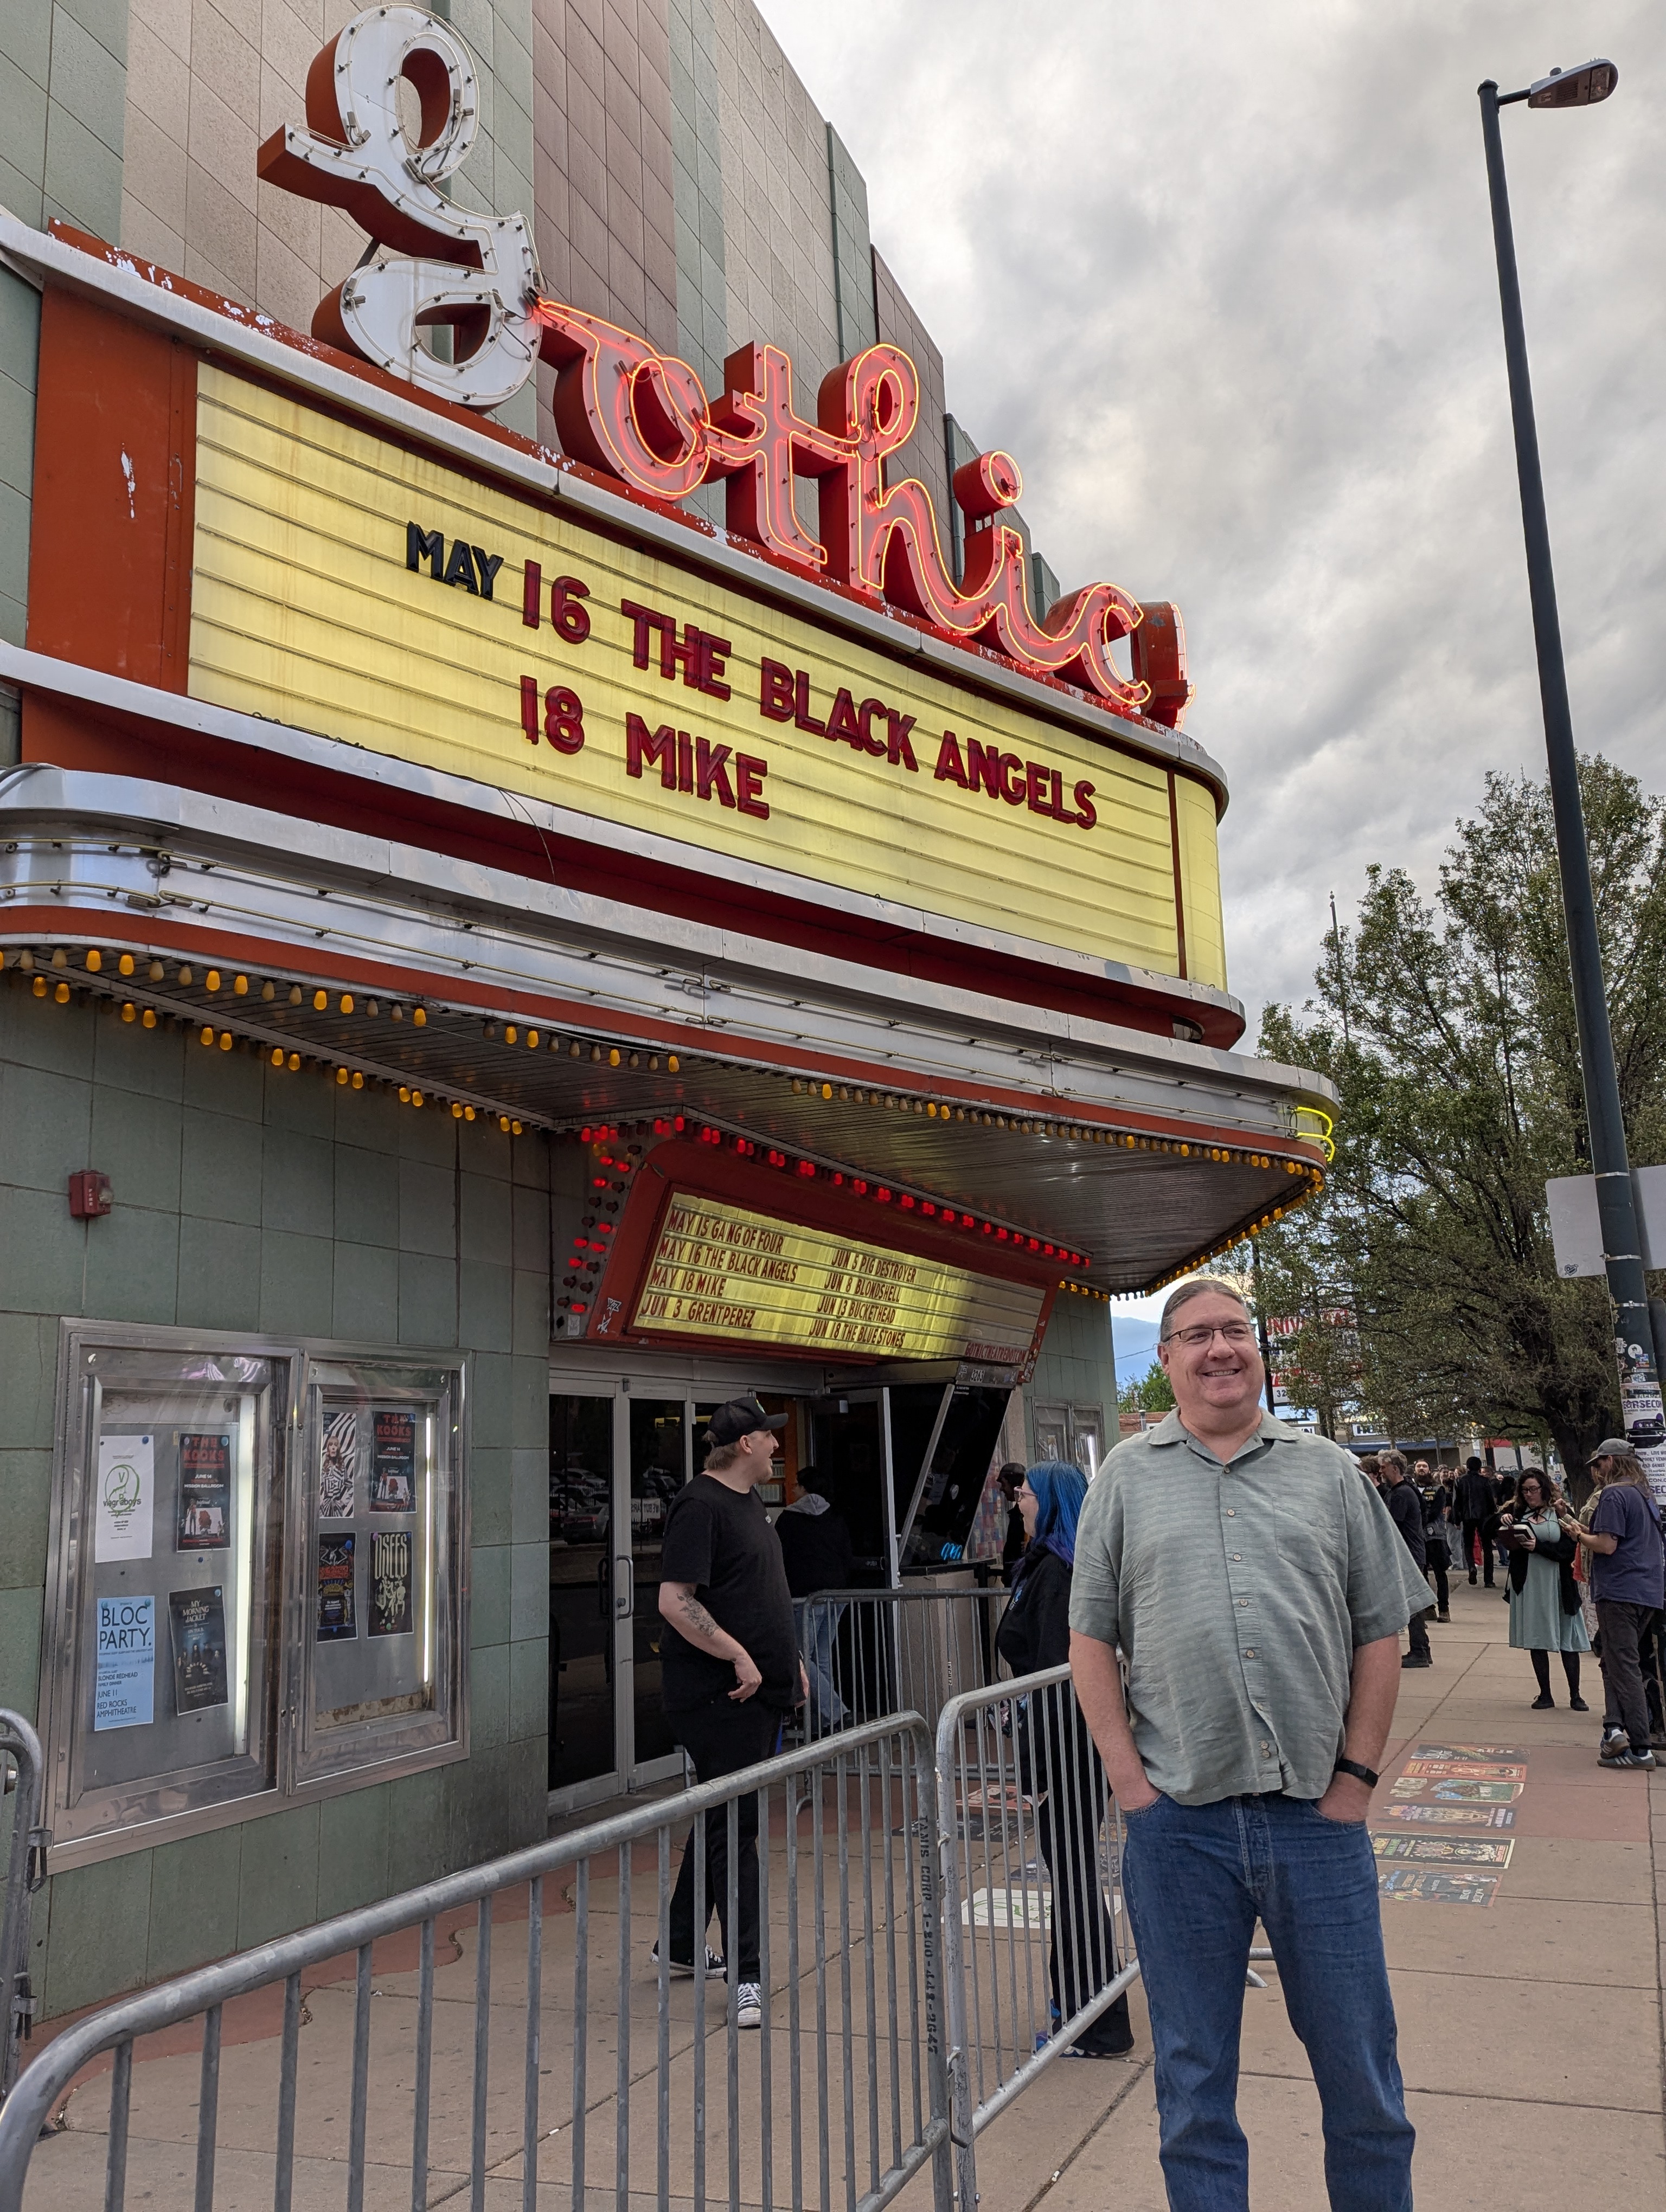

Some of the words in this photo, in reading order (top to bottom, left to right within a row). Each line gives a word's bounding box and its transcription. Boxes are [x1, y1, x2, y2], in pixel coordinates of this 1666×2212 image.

[258, 3, 1161, 710] Gothic
[406, 520, 504, 601] MAY
[522, 559, 591, 645] 16
[620, 598, 732, 702] THE
[760, 656, 920, 773] BLACK
[933, 730, 1098, 831] ANGELS
[520, 674, 585, 755] 18
[626, 711, 770, 820] MIKE
[667, 1209, 695, 1233] MAY
[695, 1217, 708, 1237] 15
[711, 1219, 742, 1246] GANG
[742, 1228, 758, 1248] OF
[758, 1231, 784, 1255] FOUR
[657, 1237, 686, 1261] MAY
[687, 1243, 702, 1264] 16
[704, 1246, 726, 1270] THE
[727, 1251, 761, 1277] BLACK
[760, 1259, 799, 1283] ANGELS
[831, 1249, 851, 1269] JUN
[851, 1255, 858, 1270] 5
[860, 1256, 875, 1274] PIG
[875, 1259, 917, 1283] DESTROYER
[649, 1266, 678, 1289] MAY
[681, 1271, 695, 1291] 18
[696, 1276, 727, 1297] MIKE
[824, 1272, 844, 1291] JUN
[845, 1277, 852, 1293] 8
[854, 1278, 902, 1302] BLONDSHELL
[640, 1294, 668, 1317] JUN
[672, 1298, 682, 1319] 3
[688, 1301, 756, 1329] GRENTPEREZ
[817, 1295, 835, 1315] JUN
[837, 1299, 847, 1316] 13
[848, 1301, 896, 1324] BUCKETHEAD
[809, 1320, 830, 1338] JUN
[830, 1322, 842, 1339] 18
[842, 1324, 858, 1341] THE
[857, 1326, 876, 1345] BLUE
[876, 1329, 906, 1348] STONES
[376, 1424, 412, 1437] KOOKS
[374, 1533, 408, 1580] OSEES
[101, 1605, 148, 1627] BLOC
[182, 1605, 209, 1616] MORNING
[185, 1613, 207, 1623] JACKET
[191, 1600, 201, 1608] MY
[99, 1627, 152, 1650] PARTY.
[97, 1690, 111, 1700] JUNE
[108, 1699, 127, 1708] ROCKS
[96, 1706, 137, 1718] AMPHITHEATRE
[919, 1815, 930, 1858] TAMIS
[921, 1865, 933, 1901] CORP
